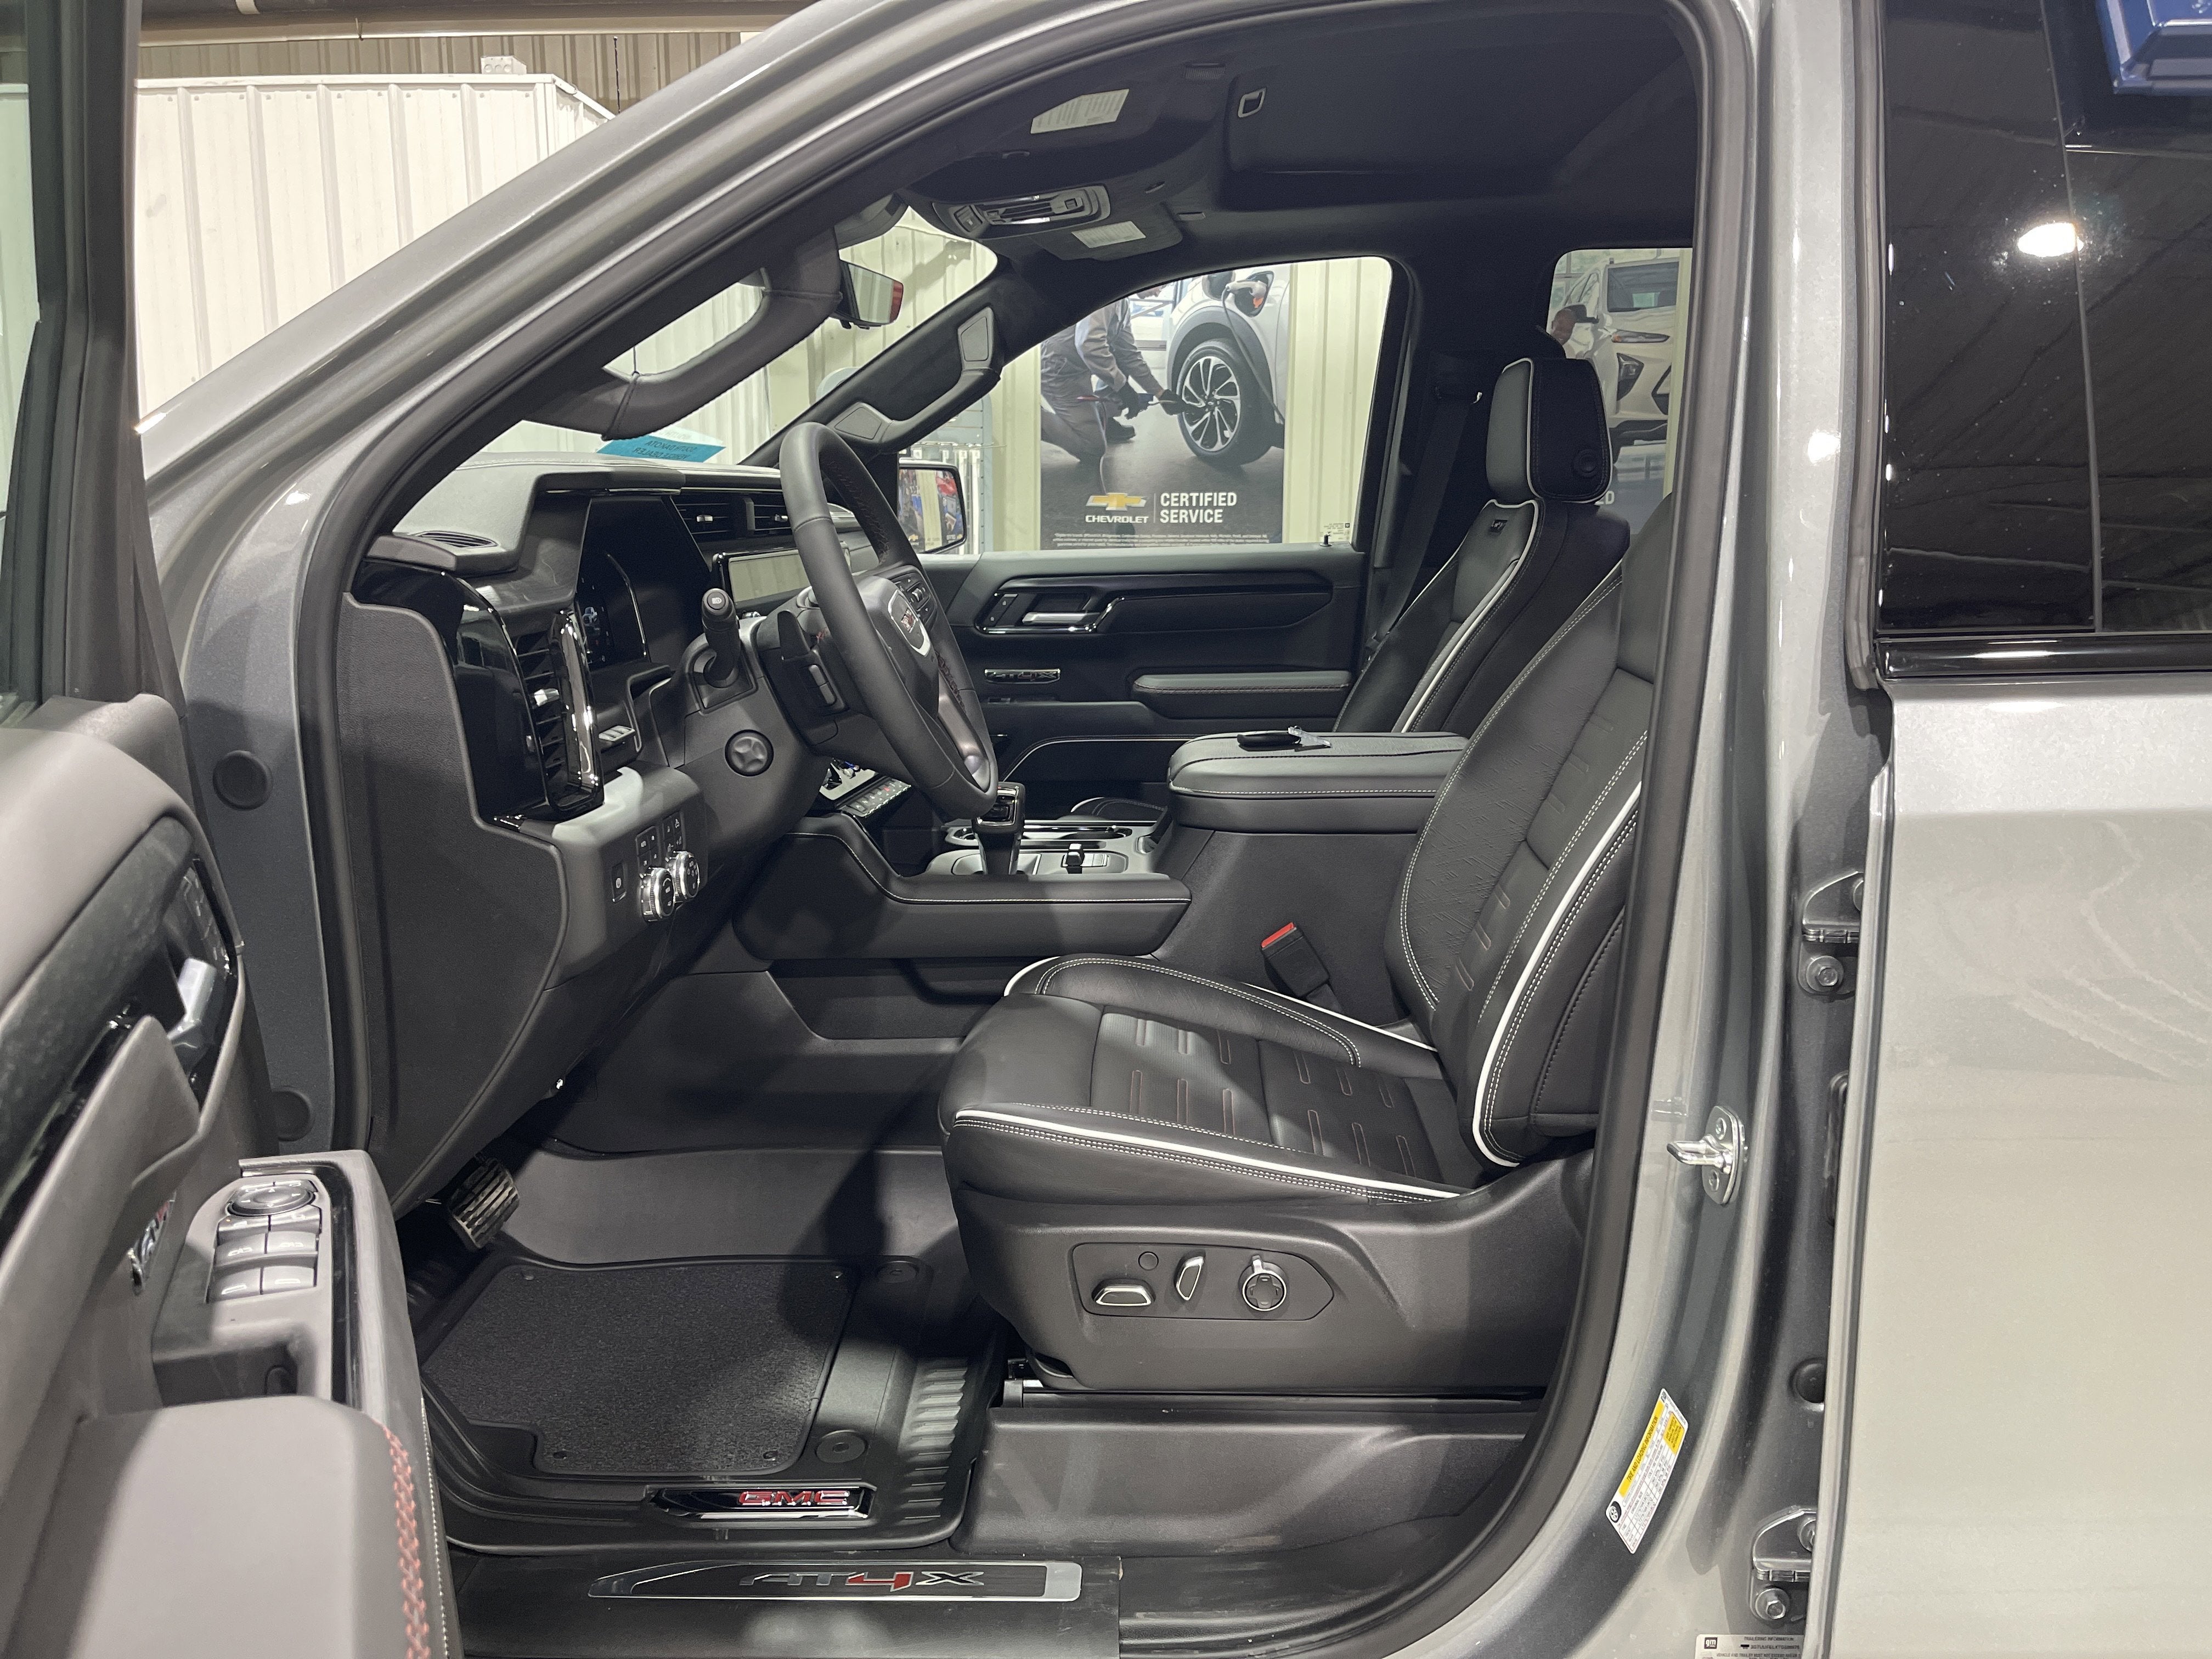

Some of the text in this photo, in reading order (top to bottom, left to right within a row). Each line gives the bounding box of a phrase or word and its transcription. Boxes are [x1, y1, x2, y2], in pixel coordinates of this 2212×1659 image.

[1160, 493, 1237, 506] CERTIFIED
[1085, 515, 1149, 523] CHEVROLET
[1160, 509, 1223, 523] SERVICE
[738, 1491, 850, 1505] GMC
[739, 1571, 984, 1592] AT4X
[1705, 1639, 1717, 1647] gm
